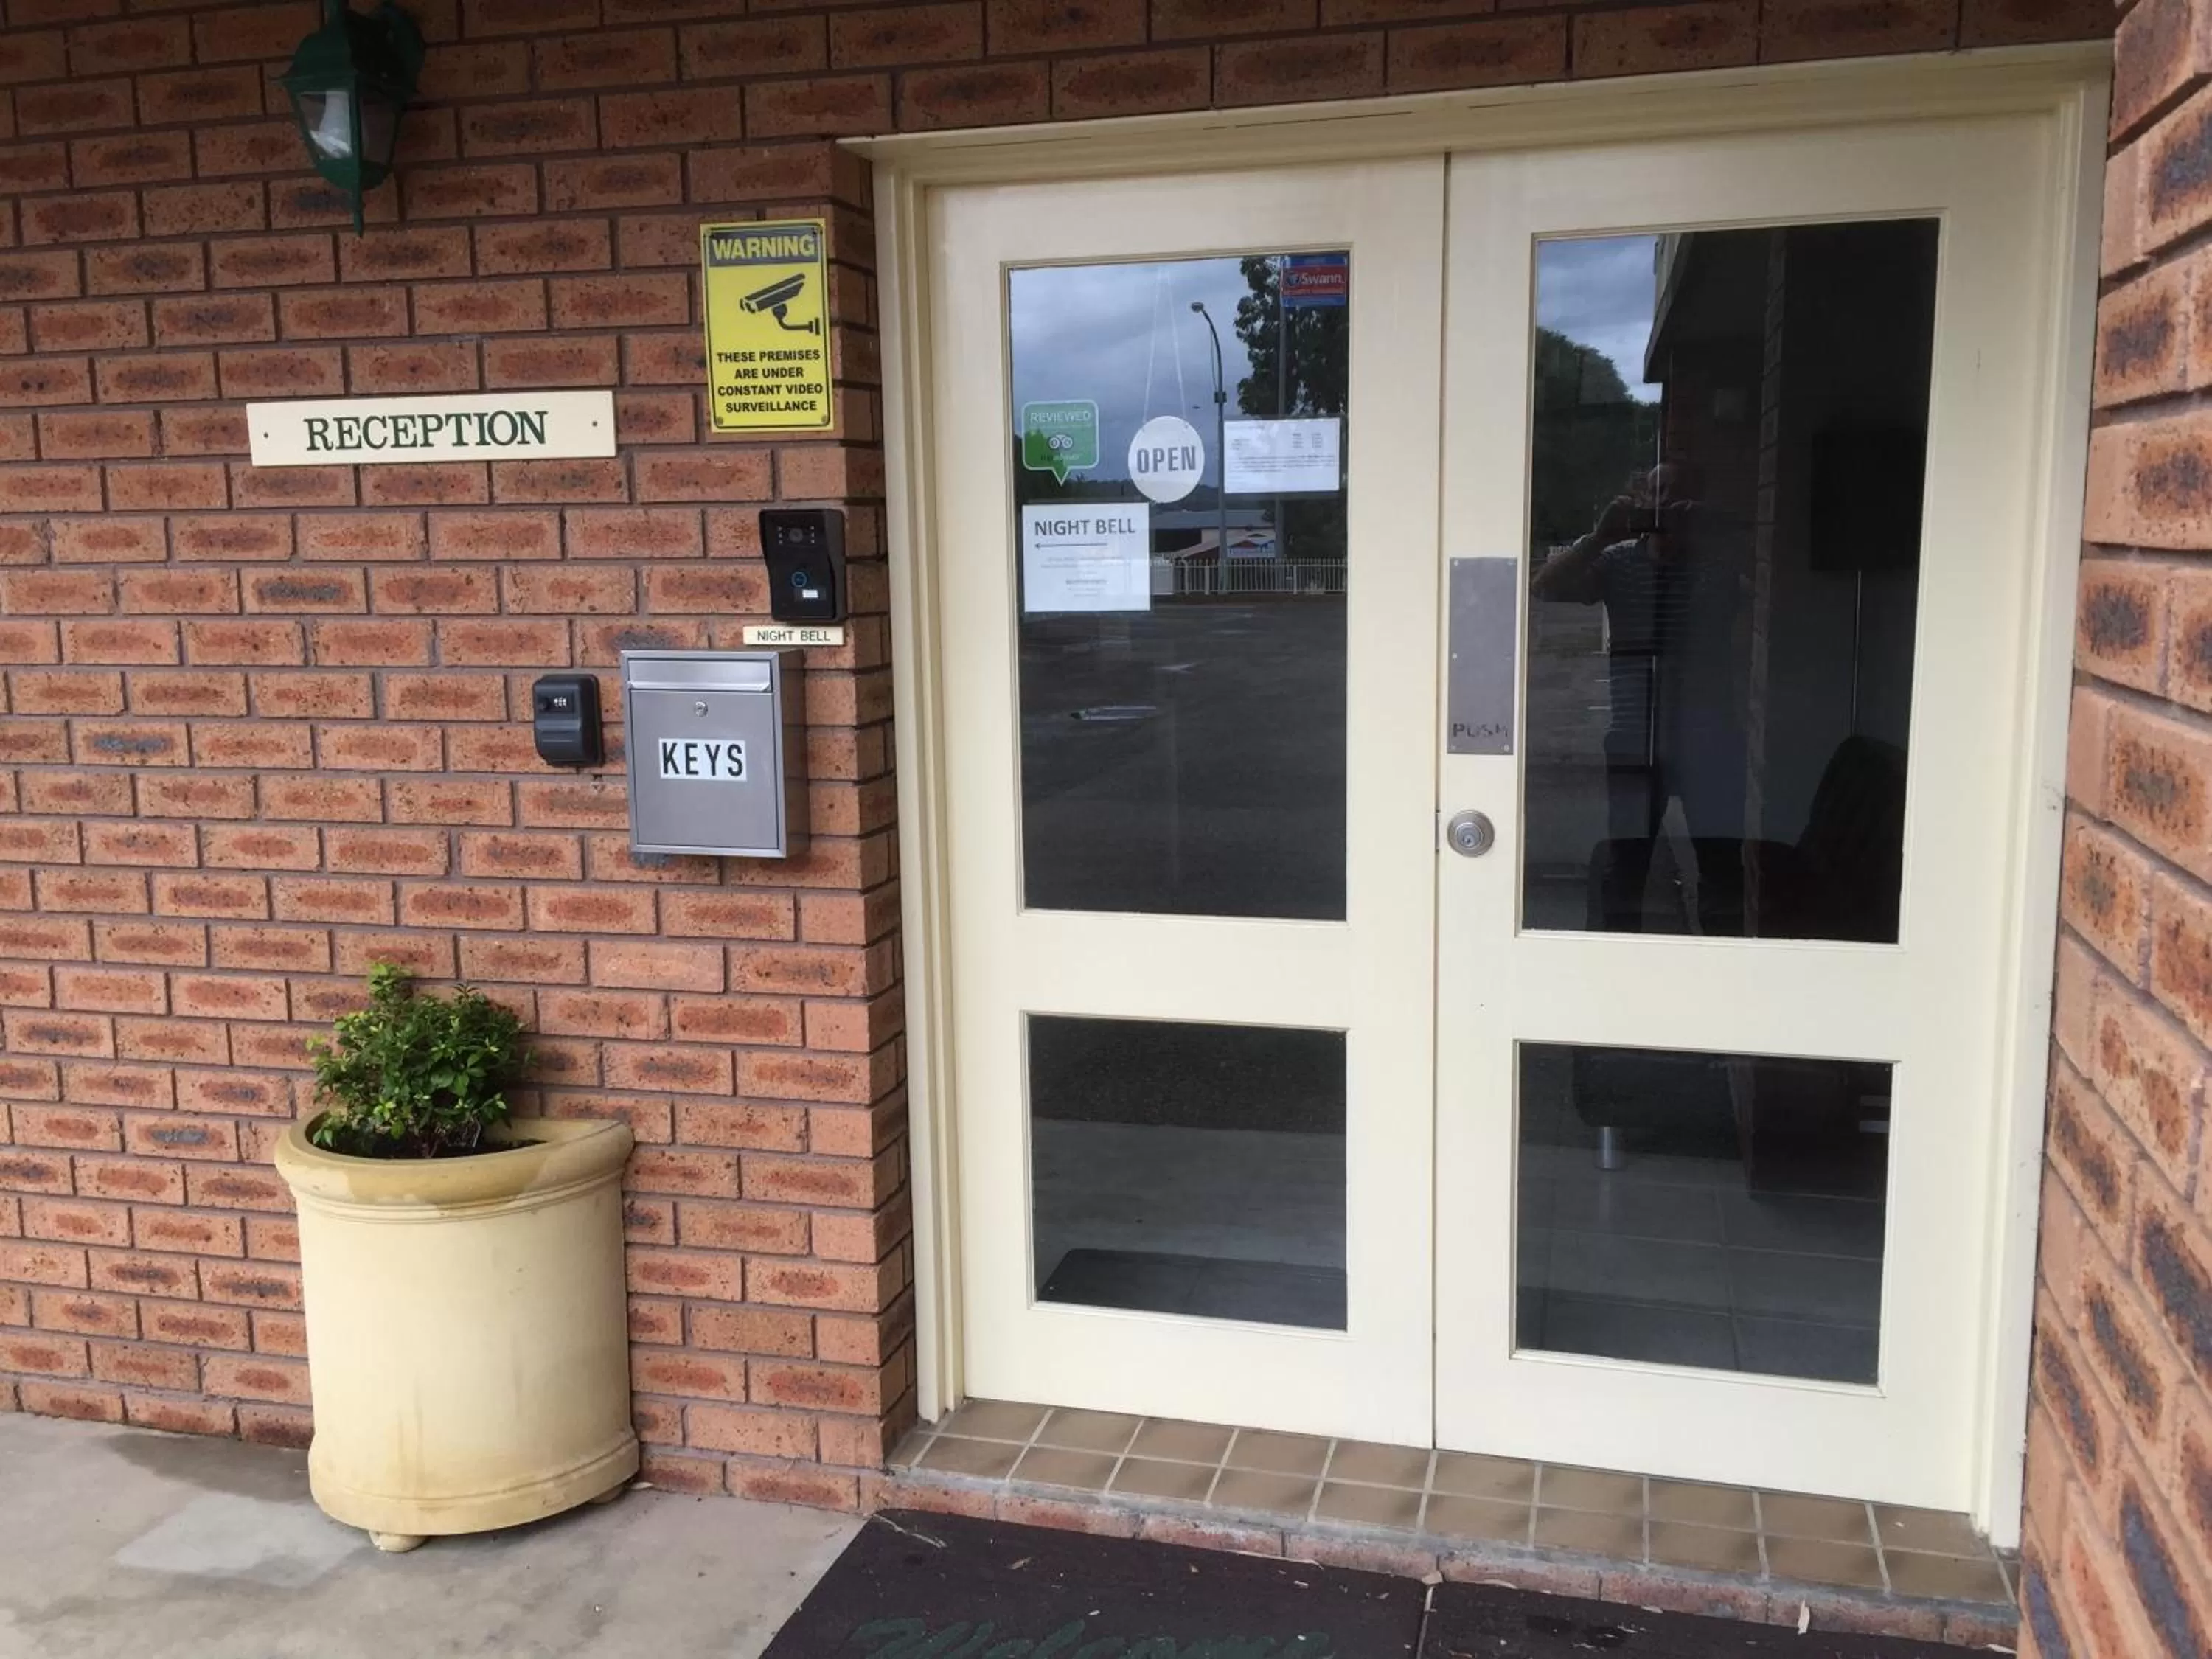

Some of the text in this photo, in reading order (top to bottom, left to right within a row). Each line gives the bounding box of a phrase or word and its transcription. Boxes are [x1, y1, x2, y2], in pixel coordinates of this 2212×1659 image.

[712, 234, 815, 260] WARNING
[717, 349, 820, 363] THESE PREMISES
[734, 367, 804, 379] ARE UNDER
[717, 383, 823, 396] CONSTANT VIDEO
[725, 400, 817, 413] SURVEILLANCE
[1030, 410, 1091, 423] REVIEWED
[304, 410, 549, 451] RECEPTION
[1137, 445, 1196, 473] OPEN
[1034, 518, 1136, 536] NIGHT BELL
[757, 630, 831, 641] NIGHT BELL
[662, 742, 744, 777] KEYS
